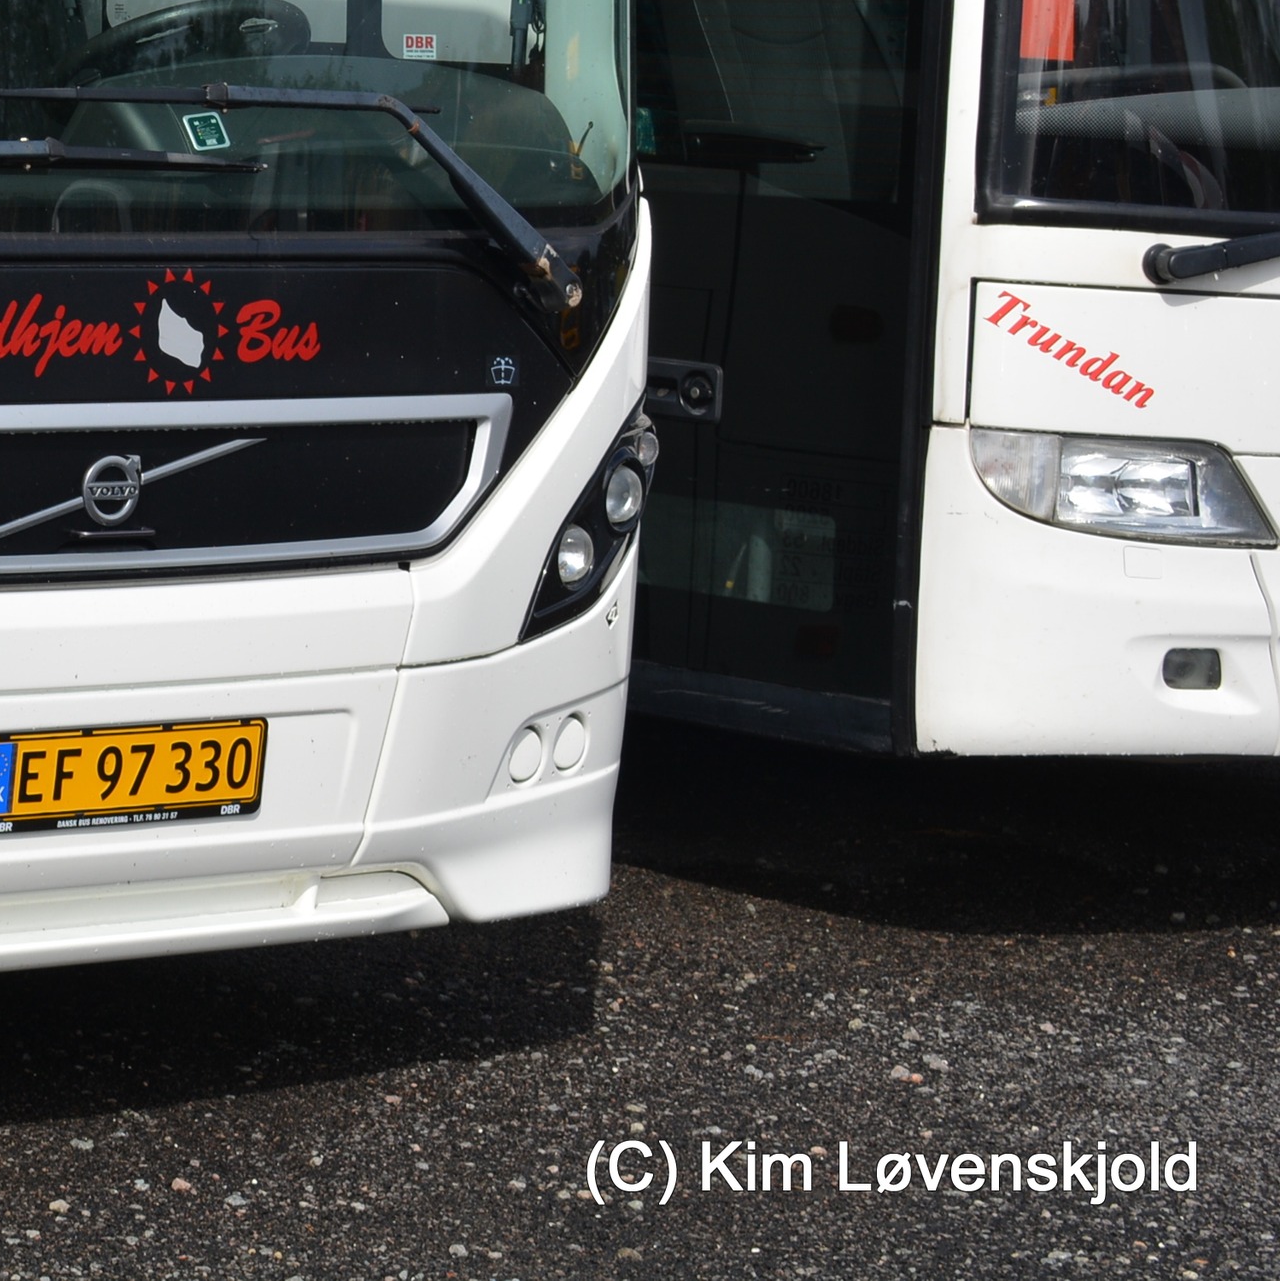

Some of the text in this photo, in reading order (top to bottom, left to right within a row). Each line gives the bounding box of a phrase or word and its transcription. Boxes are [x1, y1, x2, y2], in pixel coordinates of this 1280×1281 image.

[405, 36, 434, 49] DBR
[236, 299, 320, 363] Bus
[983, 290, 1155, 409] Trundan
[88, 486, 138, 496] VOLVO
[18, 737, 253, 803] EF 97 330
[221, 804, 240, 815] DBR
[57, 820, 78, 828] DANSK
